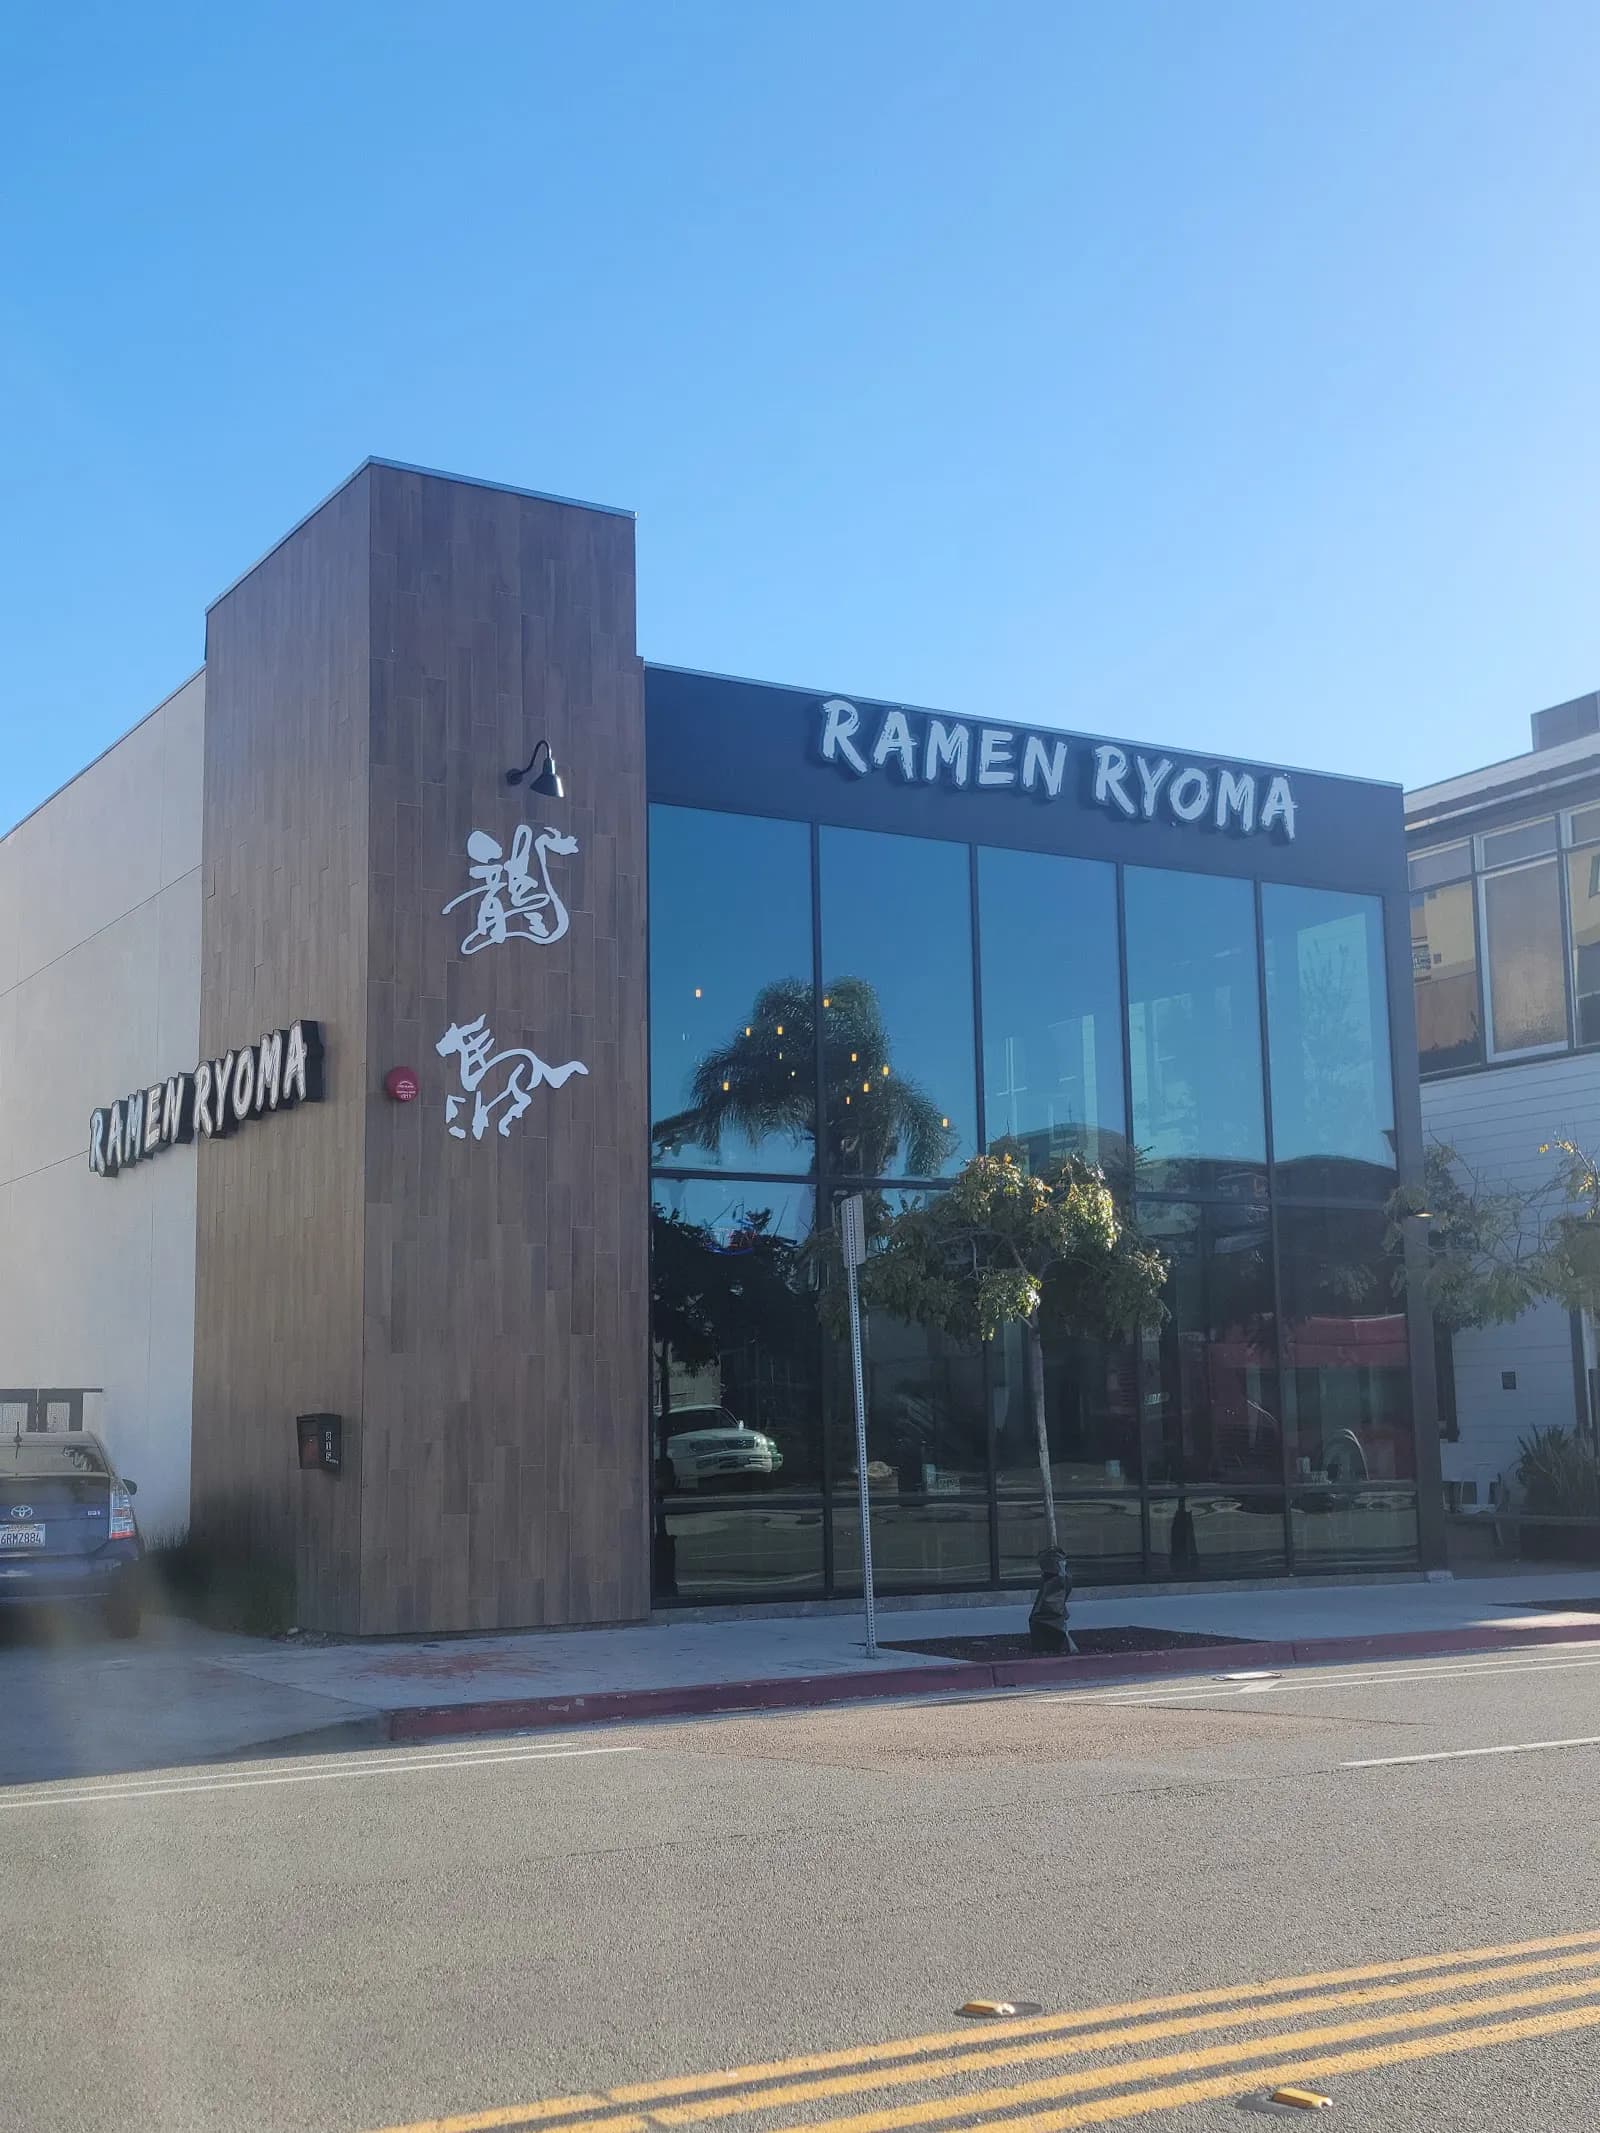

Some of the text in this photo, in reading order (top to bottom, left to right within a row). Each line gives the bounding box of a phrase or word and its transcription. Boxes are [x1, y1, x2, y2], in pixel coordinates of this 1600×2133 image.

[821, 698, 1298, 841] RAMEN RYOMA
[90, 1019, 309, 1177] RAMEN RYOMA
